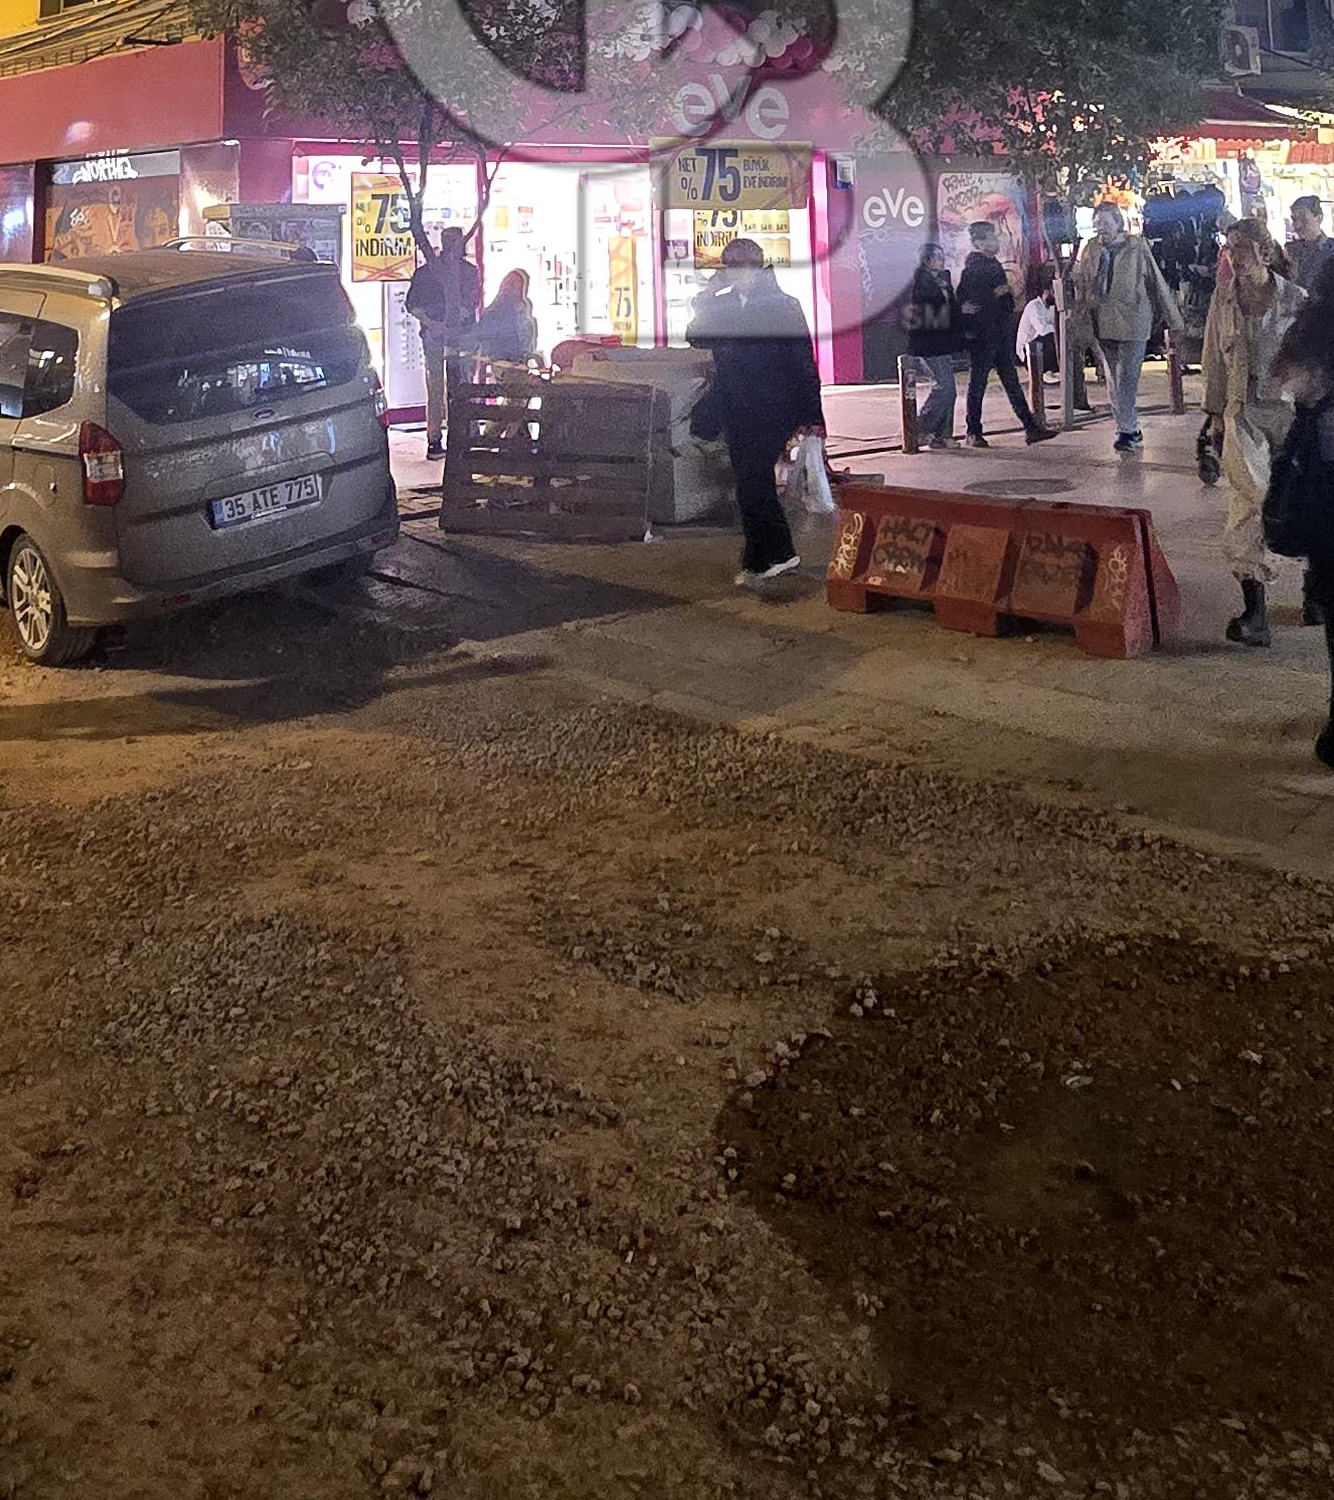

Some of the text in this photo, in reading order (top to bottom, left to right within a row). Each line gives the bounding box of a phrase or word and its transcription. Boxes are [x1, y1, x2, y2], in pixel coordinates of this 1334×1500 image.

[672, 73, 790, 139] eve
[678, 157, 697, 173] NET
[695, 148, 741, 202] 75
[862, 188, 925, 228] eve
[224, 493, 246, 519] 35
[252, 486, 279, 512] ATE
[284, 477, 315, 501] 775
